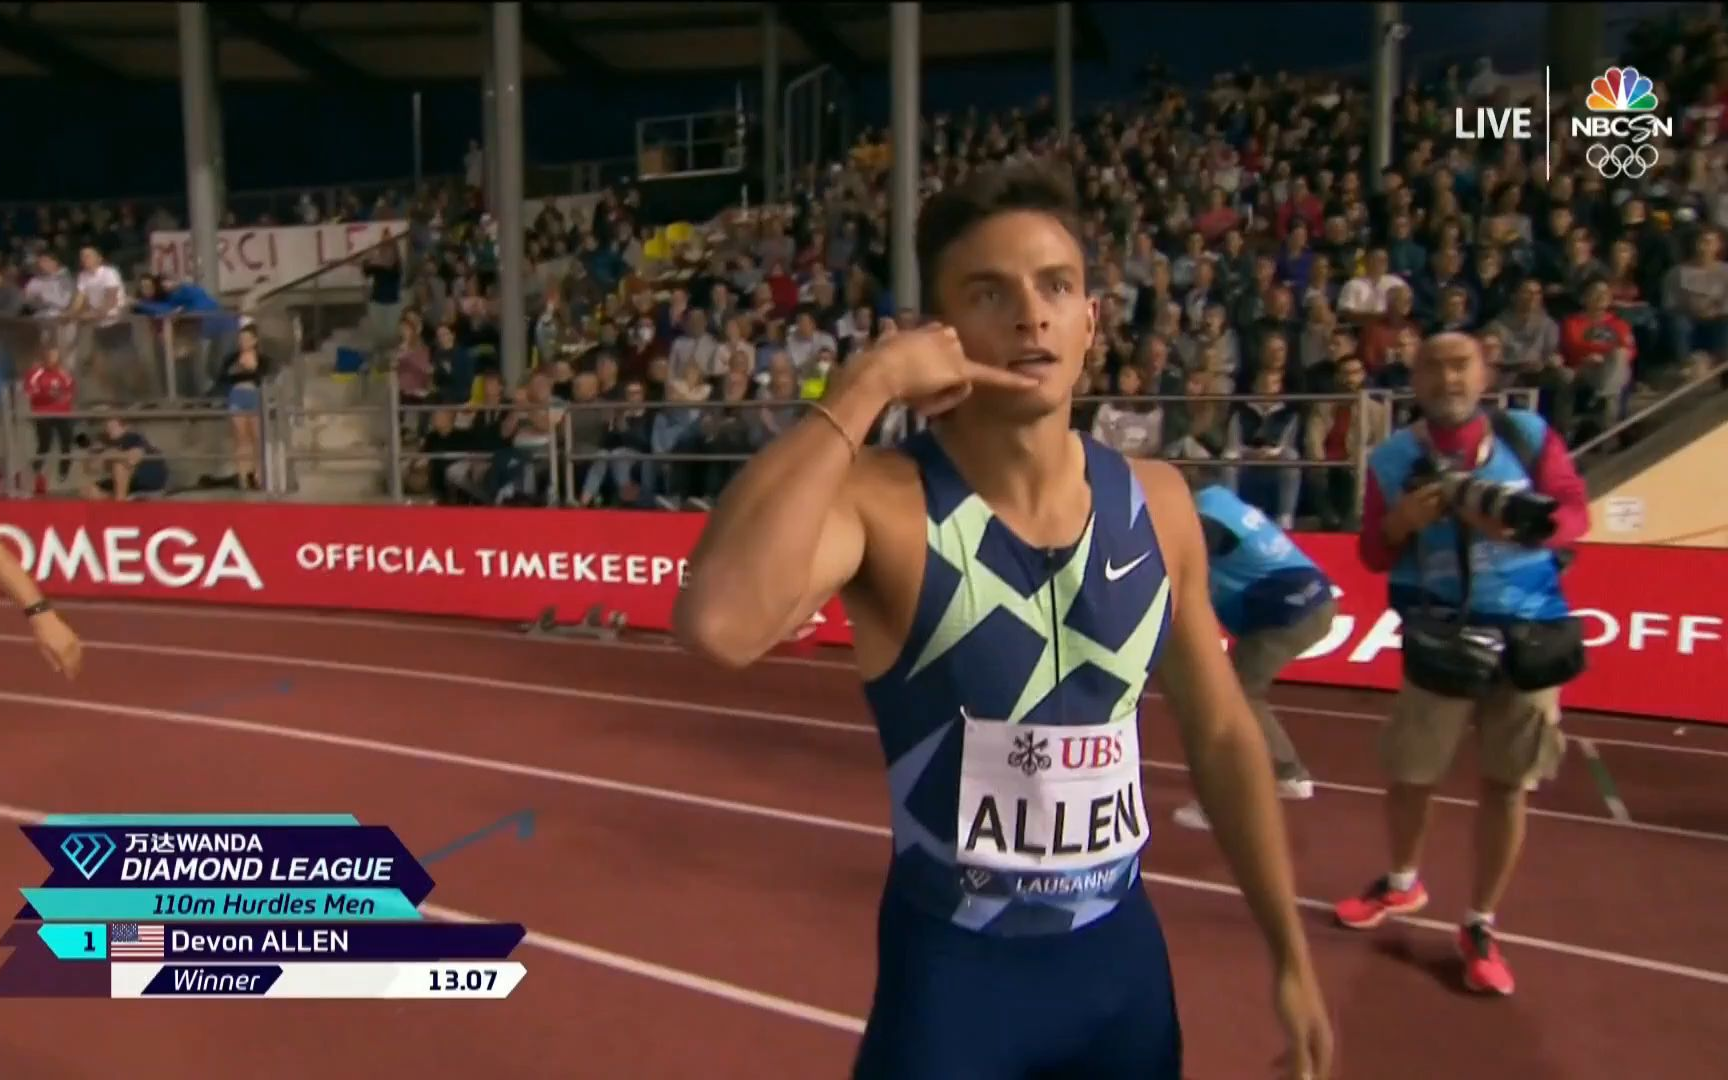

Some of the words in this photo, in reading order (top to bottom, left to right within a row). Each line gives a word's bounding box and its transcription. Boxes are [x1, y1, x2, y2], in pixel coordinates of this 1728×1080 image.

[296, 542, 466, 576] OFFICIAL
[1060, 735, 1123, 769] UBS
[965, 782, 1141, 856] ALLEN
